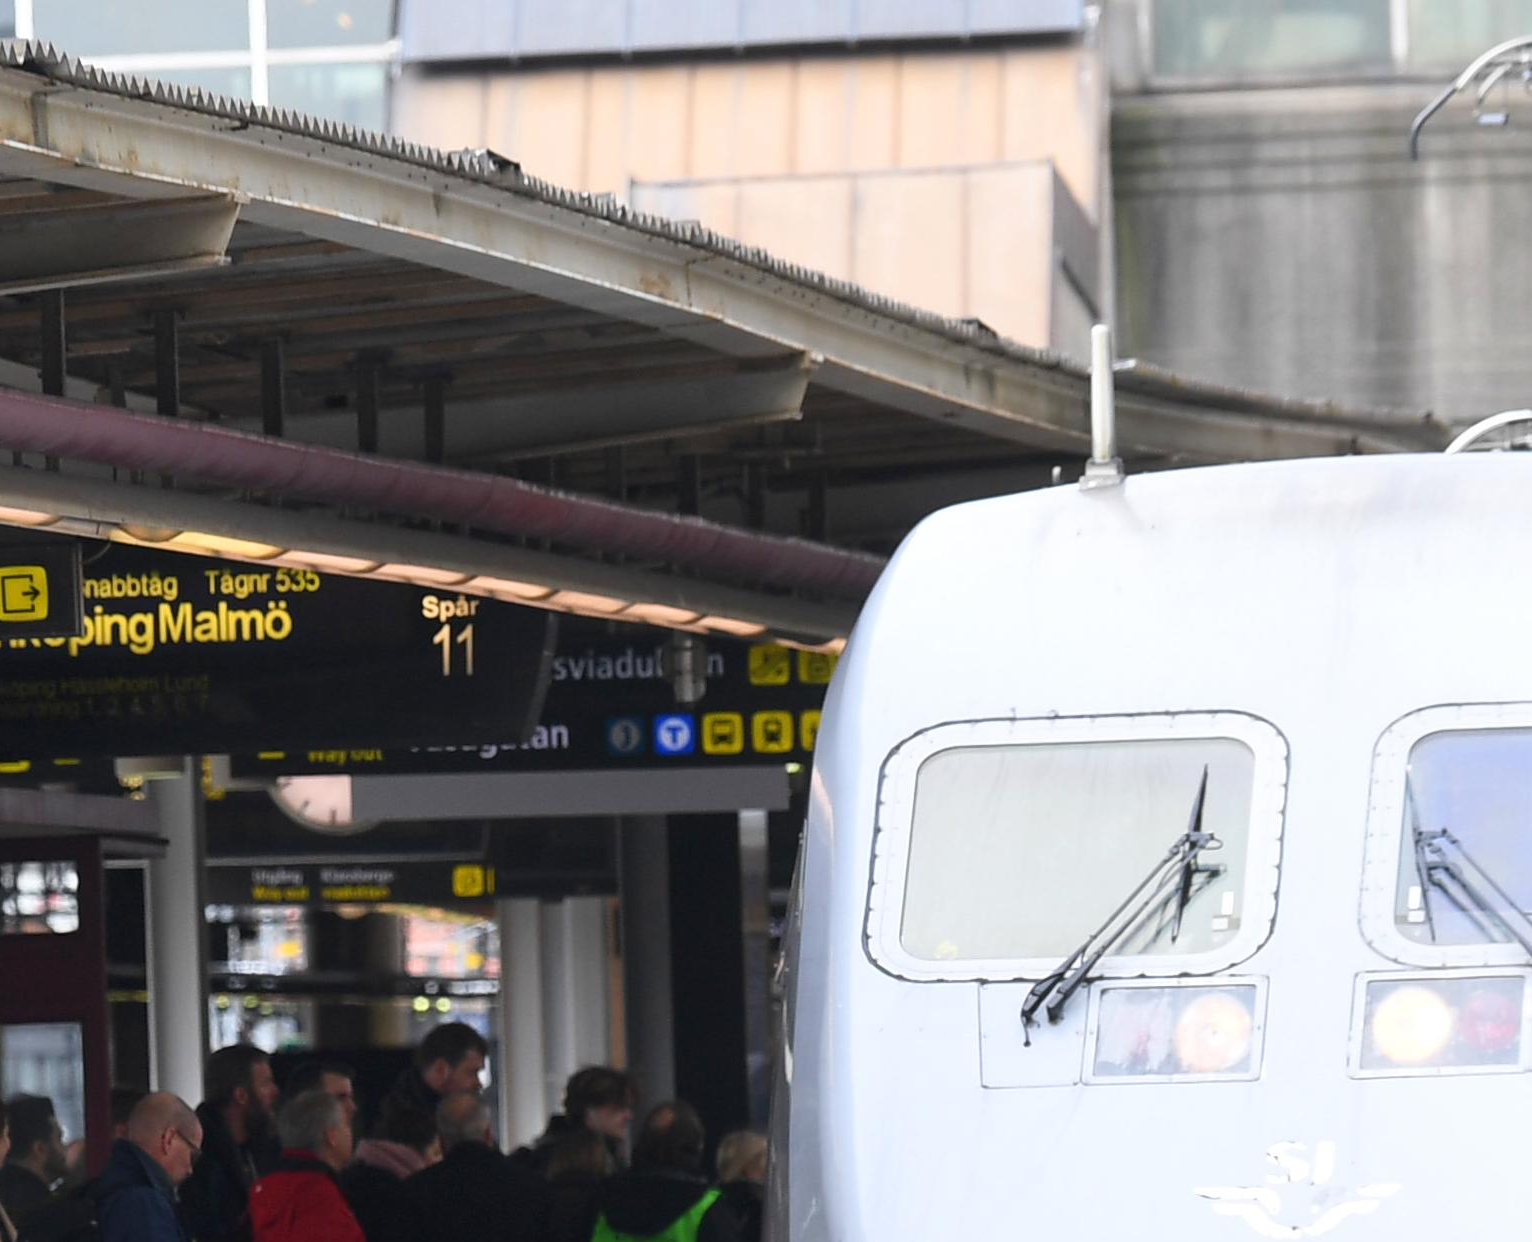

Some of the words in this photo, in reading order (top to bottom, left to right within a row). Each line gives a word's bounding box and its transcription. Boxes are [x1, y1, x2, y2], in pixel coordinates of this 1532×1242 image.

[205, 569, 270, 599] Tågnr
[275, 567, 321, 592] 535
[158, 600, 293, 644] Malmö
[422, 594, 480, 622] Spår
[433, 624, 474, 676] 11
[552, 647, 724, 682] sviadun
